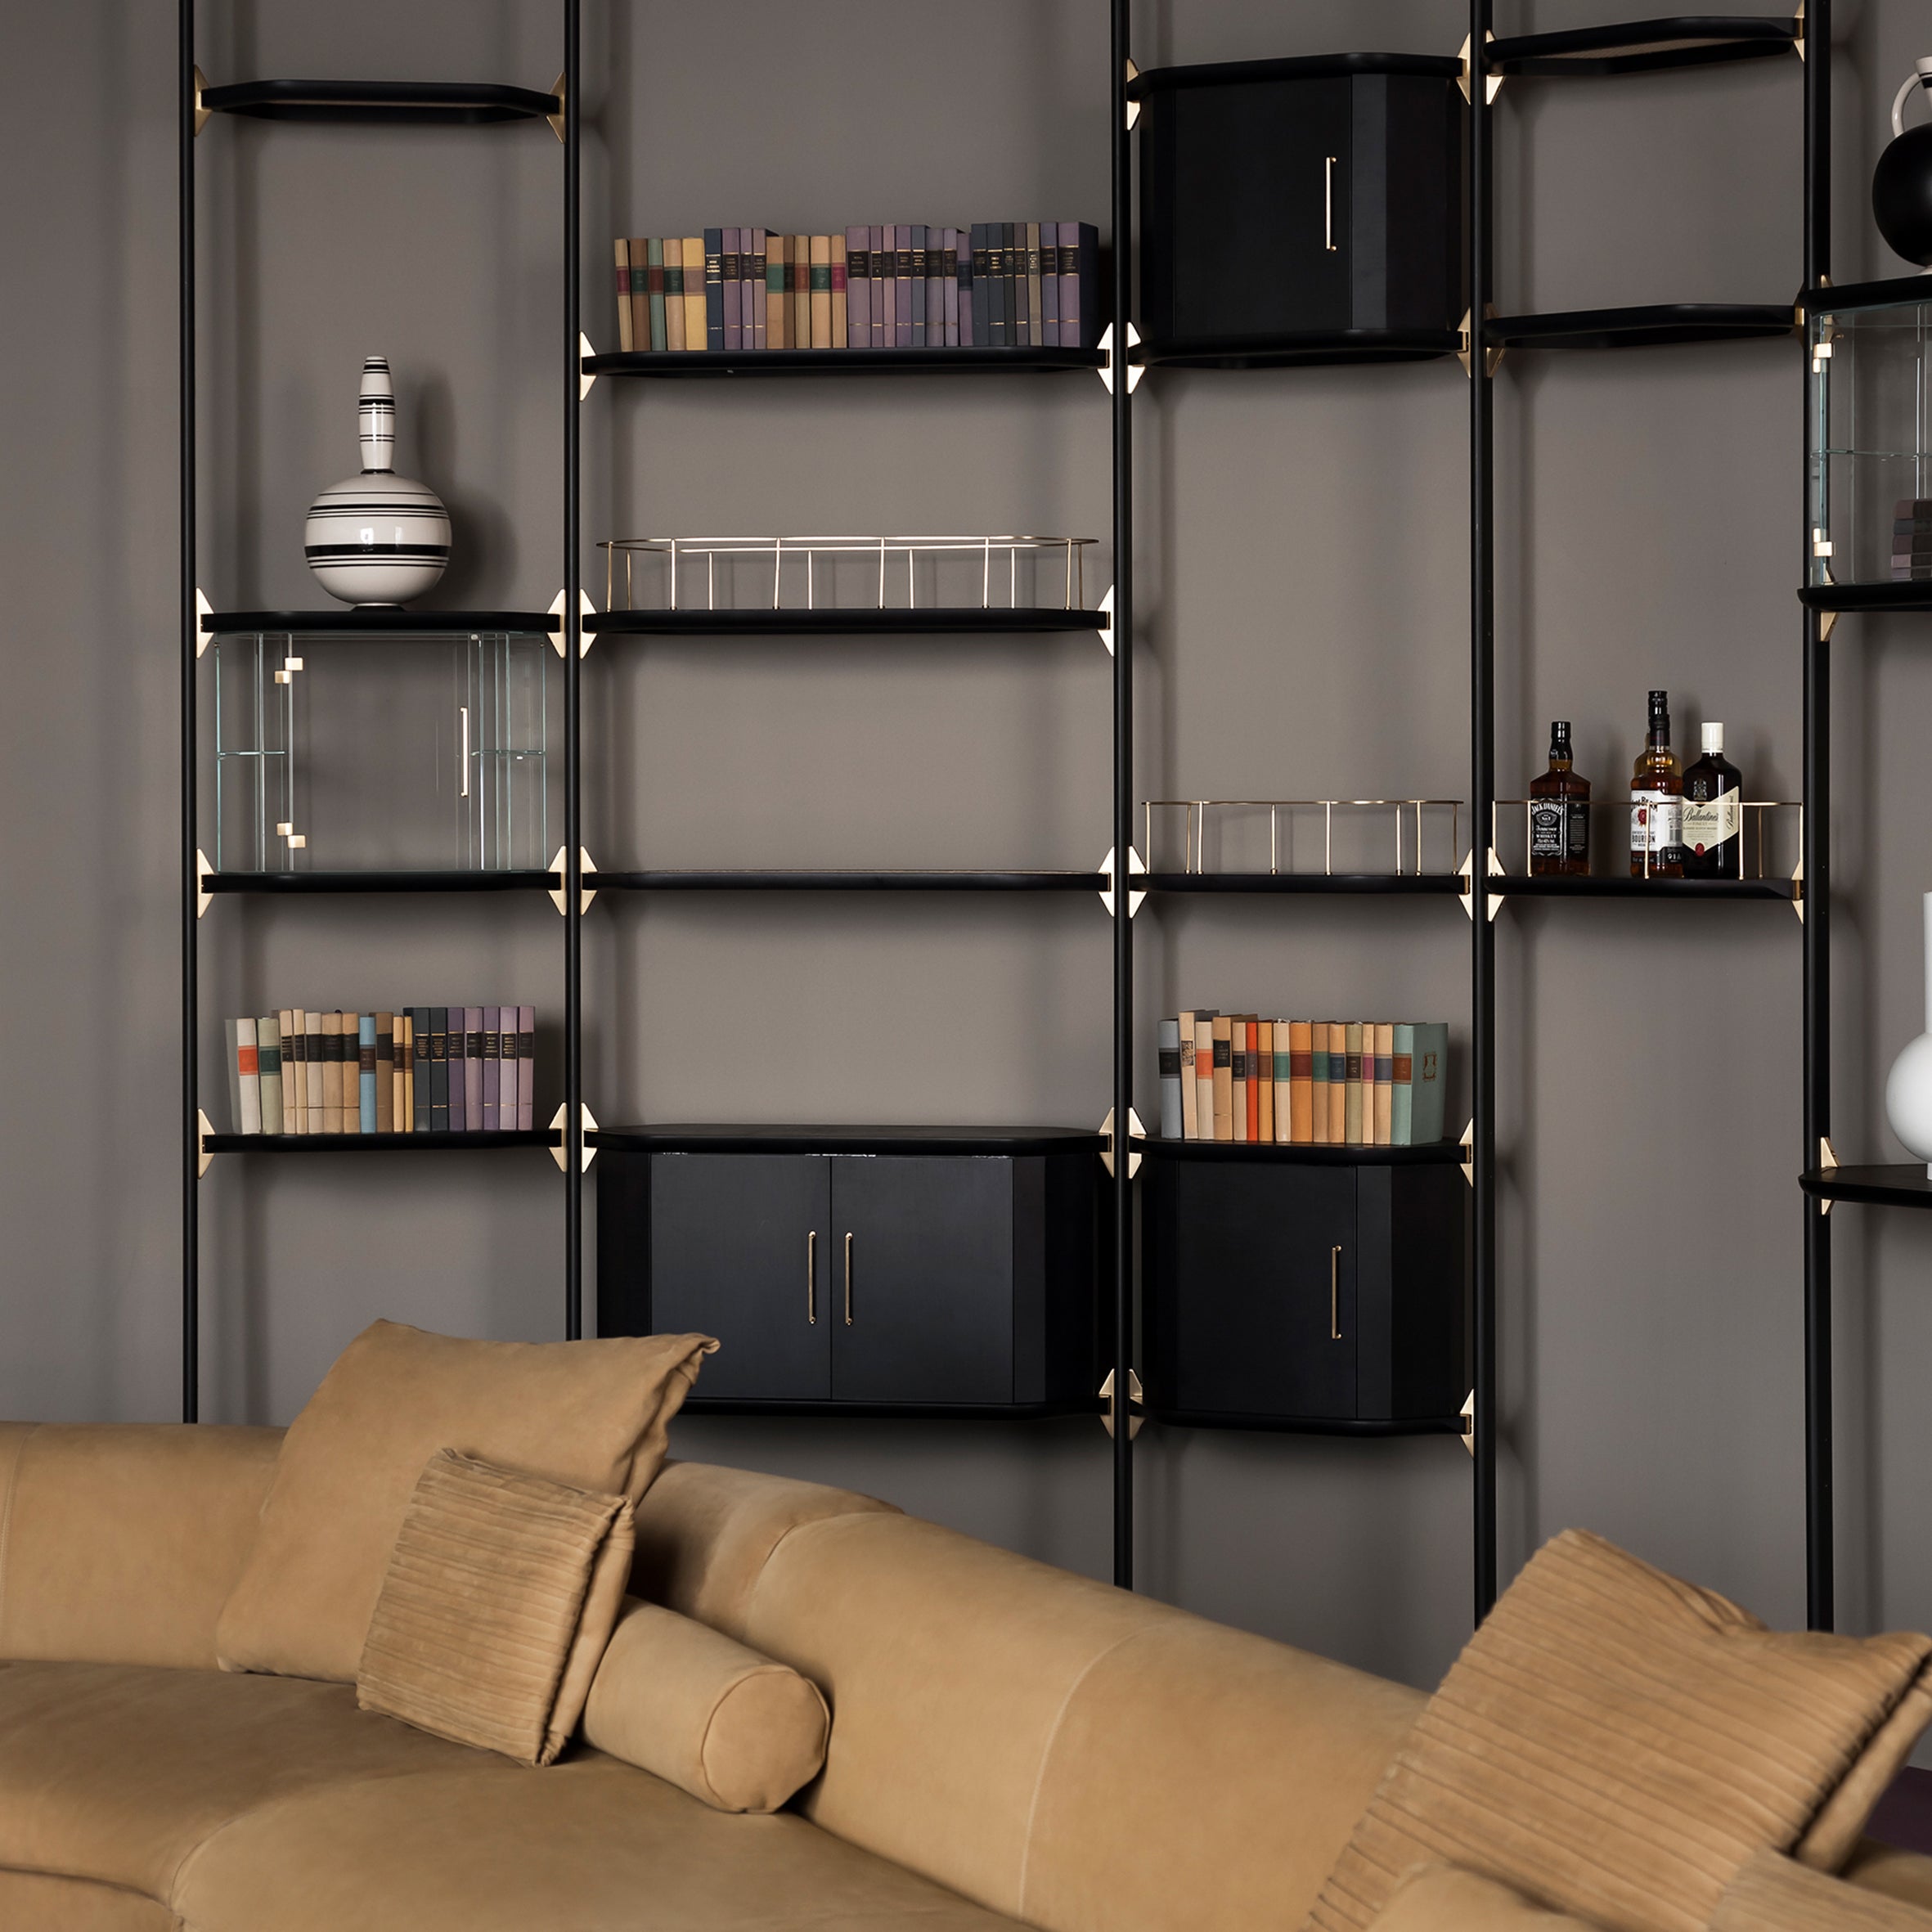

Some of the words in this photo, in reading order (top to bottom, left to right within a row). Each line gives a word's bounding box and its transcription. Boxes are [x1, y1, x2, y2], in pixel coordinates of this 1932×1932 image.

[1531, 802, 1543, 815] JACK
[1683, 806, 1719, 822] Ballantine's
[1632, 834, 1656, 842] BOURBON
